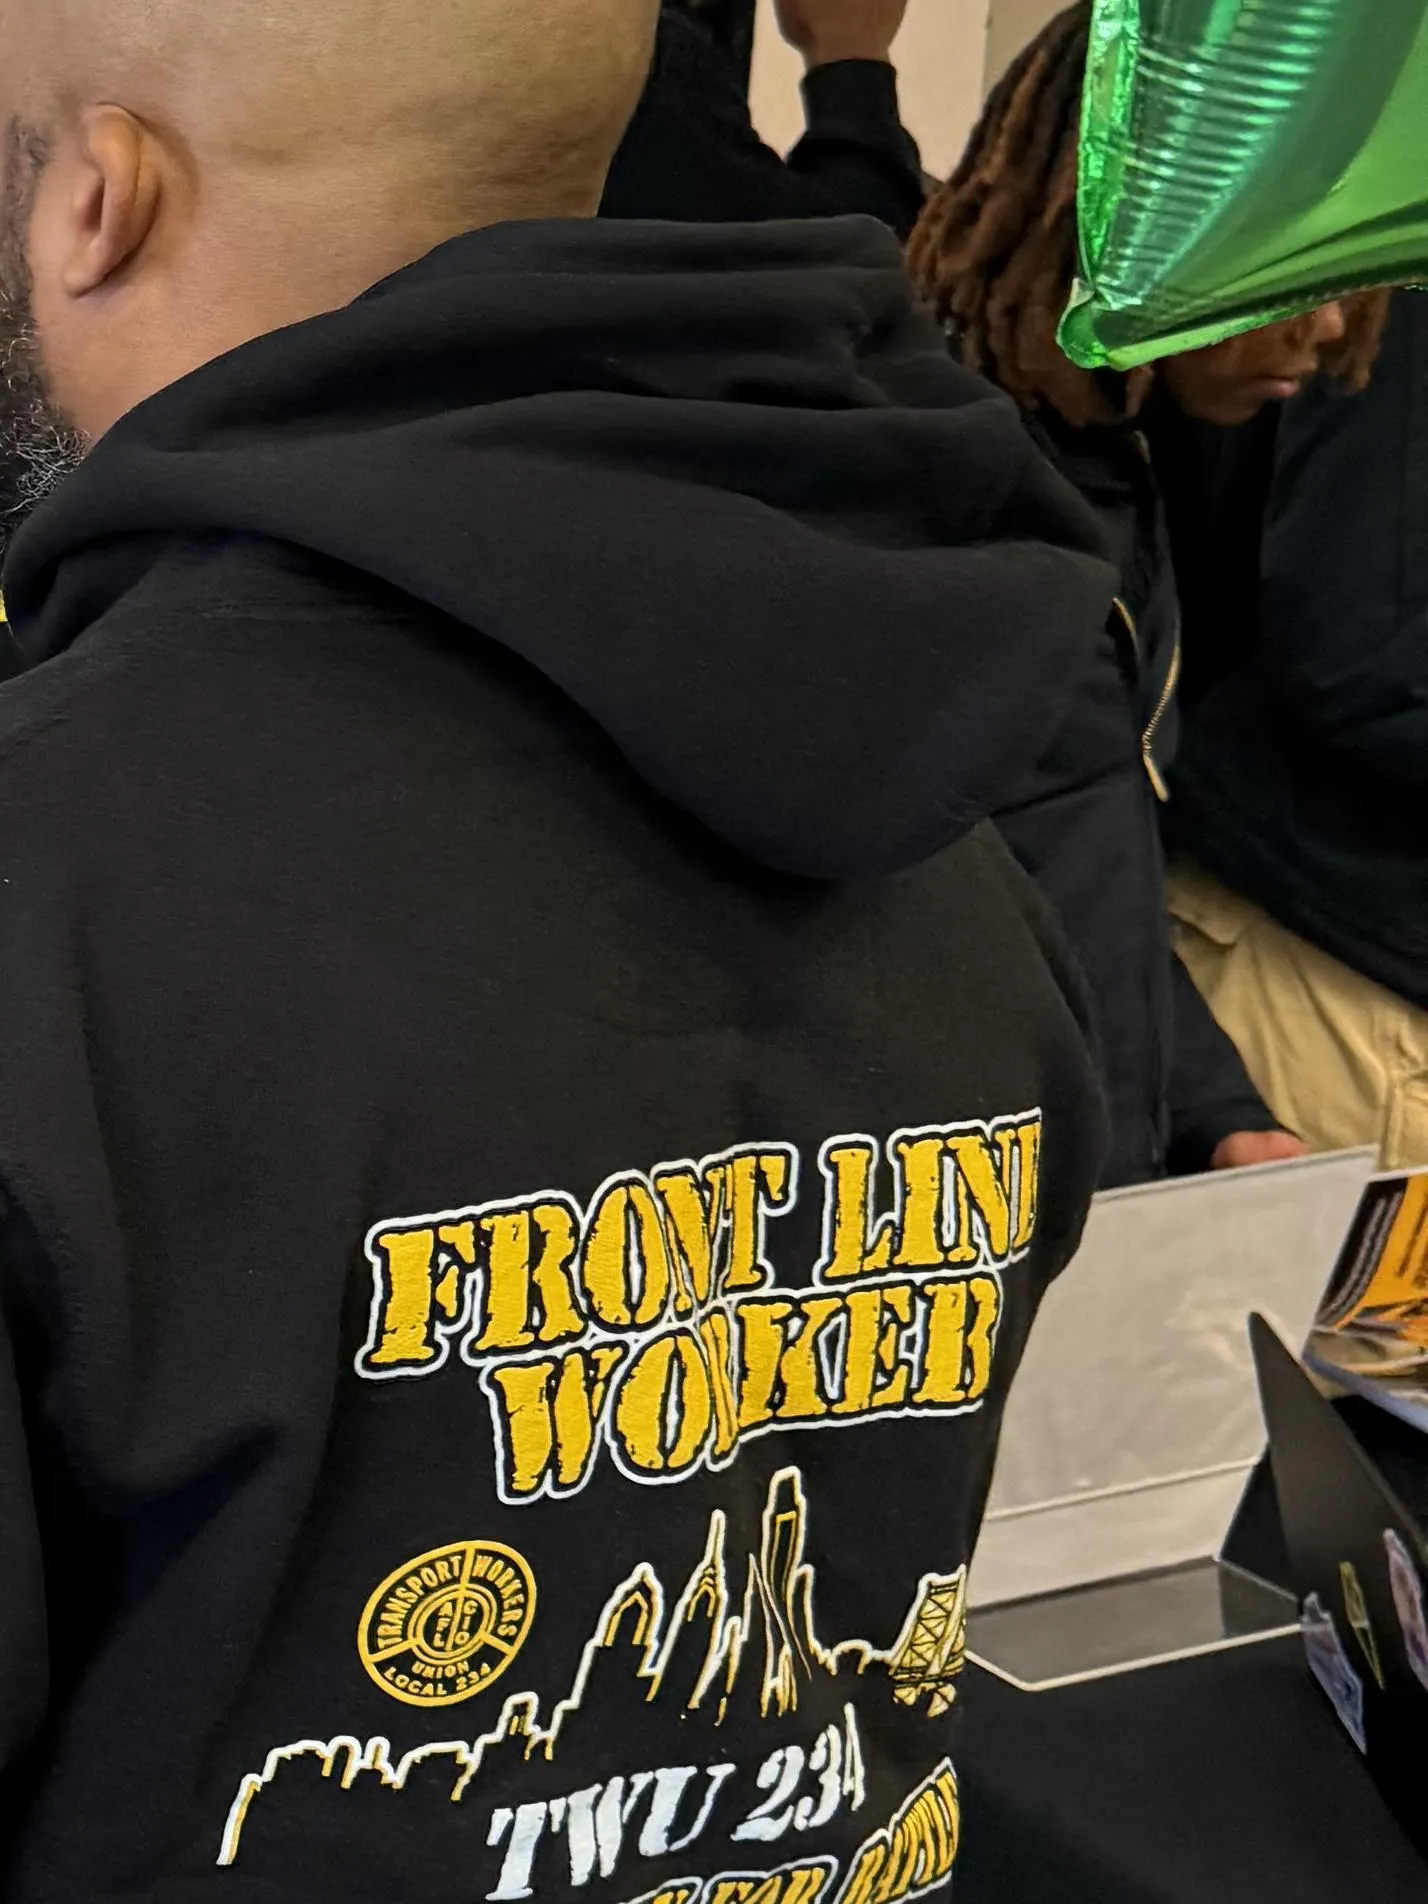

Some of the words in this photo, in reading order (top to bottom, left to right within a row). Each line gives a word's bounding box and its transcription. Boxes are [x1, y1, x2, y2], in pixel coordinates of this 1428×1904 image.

[361, 1146, 795, 1376] FRONT
[376, 1555, 463, 1650] TRANSPORT
[471, 1555, 525, 1638] WORKERS
[383, 1666, 448, 1697] LOCAL
[411, 1660, 471, 1679] UNION
[485, 1763, 738, 1902] TWU
[731, 1702, 866, 1842] 234
